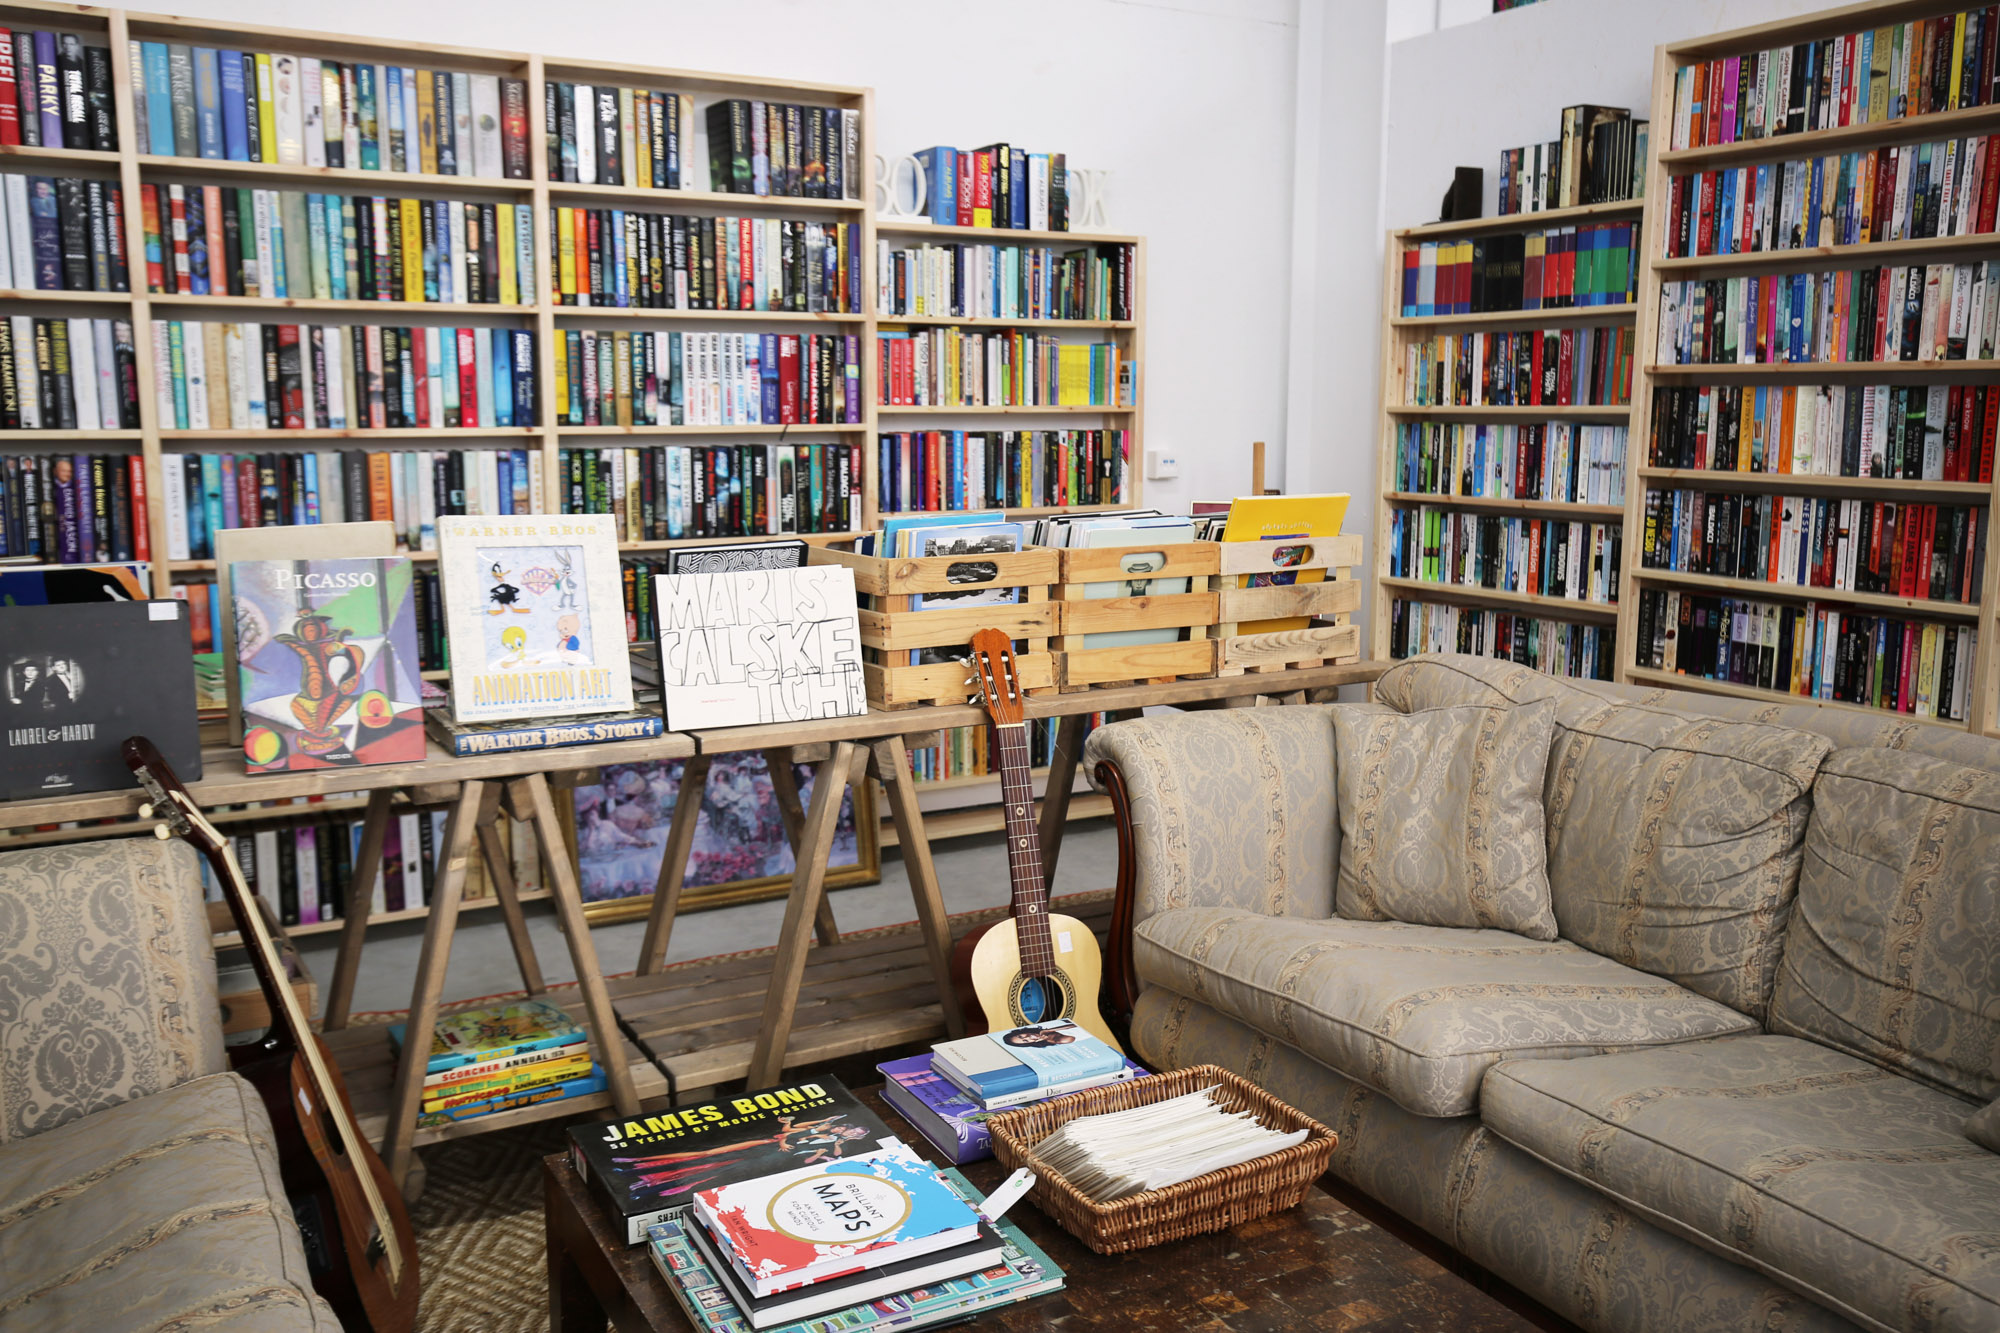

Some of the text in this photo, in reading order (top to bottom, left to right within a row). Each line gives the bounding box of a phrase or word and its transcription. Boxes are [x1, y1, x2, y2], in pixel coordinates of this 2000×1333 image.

[1862, 37, 1871, 64] thirst
[1940, 30, 1951, 90] JOANNE HARRIS
[38, 64, 59, 116] PARKY
[1738, 60, 1749, 94] NESS
[1755, 53, 1766, 125] FELIX FRANCIS Crisis
[68, 70, 85, 123] TOTAL RECALL
[963, 177, 971, 208] BOOKS
[980, 174, 989, 206] BOOKS
[1944, 168, 1952, 187] TABLE
[741, 220, 752, 278] WILBUR SMITH
[650, 257, 663, 293] SOLO
[1908, 268, 1918, 300] BALDACCI
[1954, 296, 1964, 335] stonecutter
[569, 341, 579, 384] LEE CHILD
[584, 339, 596, 394] DAN BROWN
[600, 340, 613, 394] DAN BROWN
[618, 340, 630, 394] DAN BROWN
[634, 335, 644, 389] LEE CHILD
[736, 355, 744, 380] KOONTZ
[1, 355, 17, 412] HAMILTON
[1672, 391, 1680, 420] GREY
[1929, 390, 1939, 420] MARTIN
[1963, 397, 1971, 430] we know
[1907, 430, 1913, 438] OF
[1982, 387, 1997, 473] DARK MATTER
[827, 448, 835, 470] Karin
[1946, 440, 1955, 467] RISING
[694, 464, 704, 503] BALDACCI
[63, 488, 76, 553] DAVID JASON
[453, 525, 599, 537] WARNER BROS
[1720, 503, 1731, 545] PATTERSON
[1801, 502, 1810, 534] NESS
[1814, 505, 1824, 551] MR NOBODY
[1826, 517, 1836, 546] REICHS
[1530, 528, 1539, 573] evolution
[1904, 506, 1920, 573] PETER JAMES
[274, 569, 376, 590] PICASSO
[1556, 543, 1566, 581] WIDOWS
[660, 570, 828, 630] MARIS
[1719, 618, 1729, 644] Reichs
[472, 668, 612, 706] ANIMATION ART
[9, 723, 96, 746] LAUREL & HARDY
[468, 730, 541, 752] WARNER
[545, 725, 594, 744] BROS.
[594, 720, 645, 736] STORY
[442, 1064, 500, 1082] SCORCHER
[505, 1053, 549, 1069] ANNUAL
[443, 1086, 510, 1108] Hurricane
[514, 1078, 553, 1091] ANNUAL
[1046, 1088, 1064, 1097] Dior
[602, 1083, 828, 1142] JAMES BOND
[610, 1096, 836, 1150] 50 YEARS OF MOVIE POSTERS
[810, 1210, 826, 1226] ATLAS
[812, 1182, 872, 1233] MAPS
[845, 1183, 884, 1220] BRILLIANT
[731, 1215, 741, 1226] IAN
[738, 1226, 759, 1248] WRIGHT
[799, 1210, 820, 1233] CURIOUS
